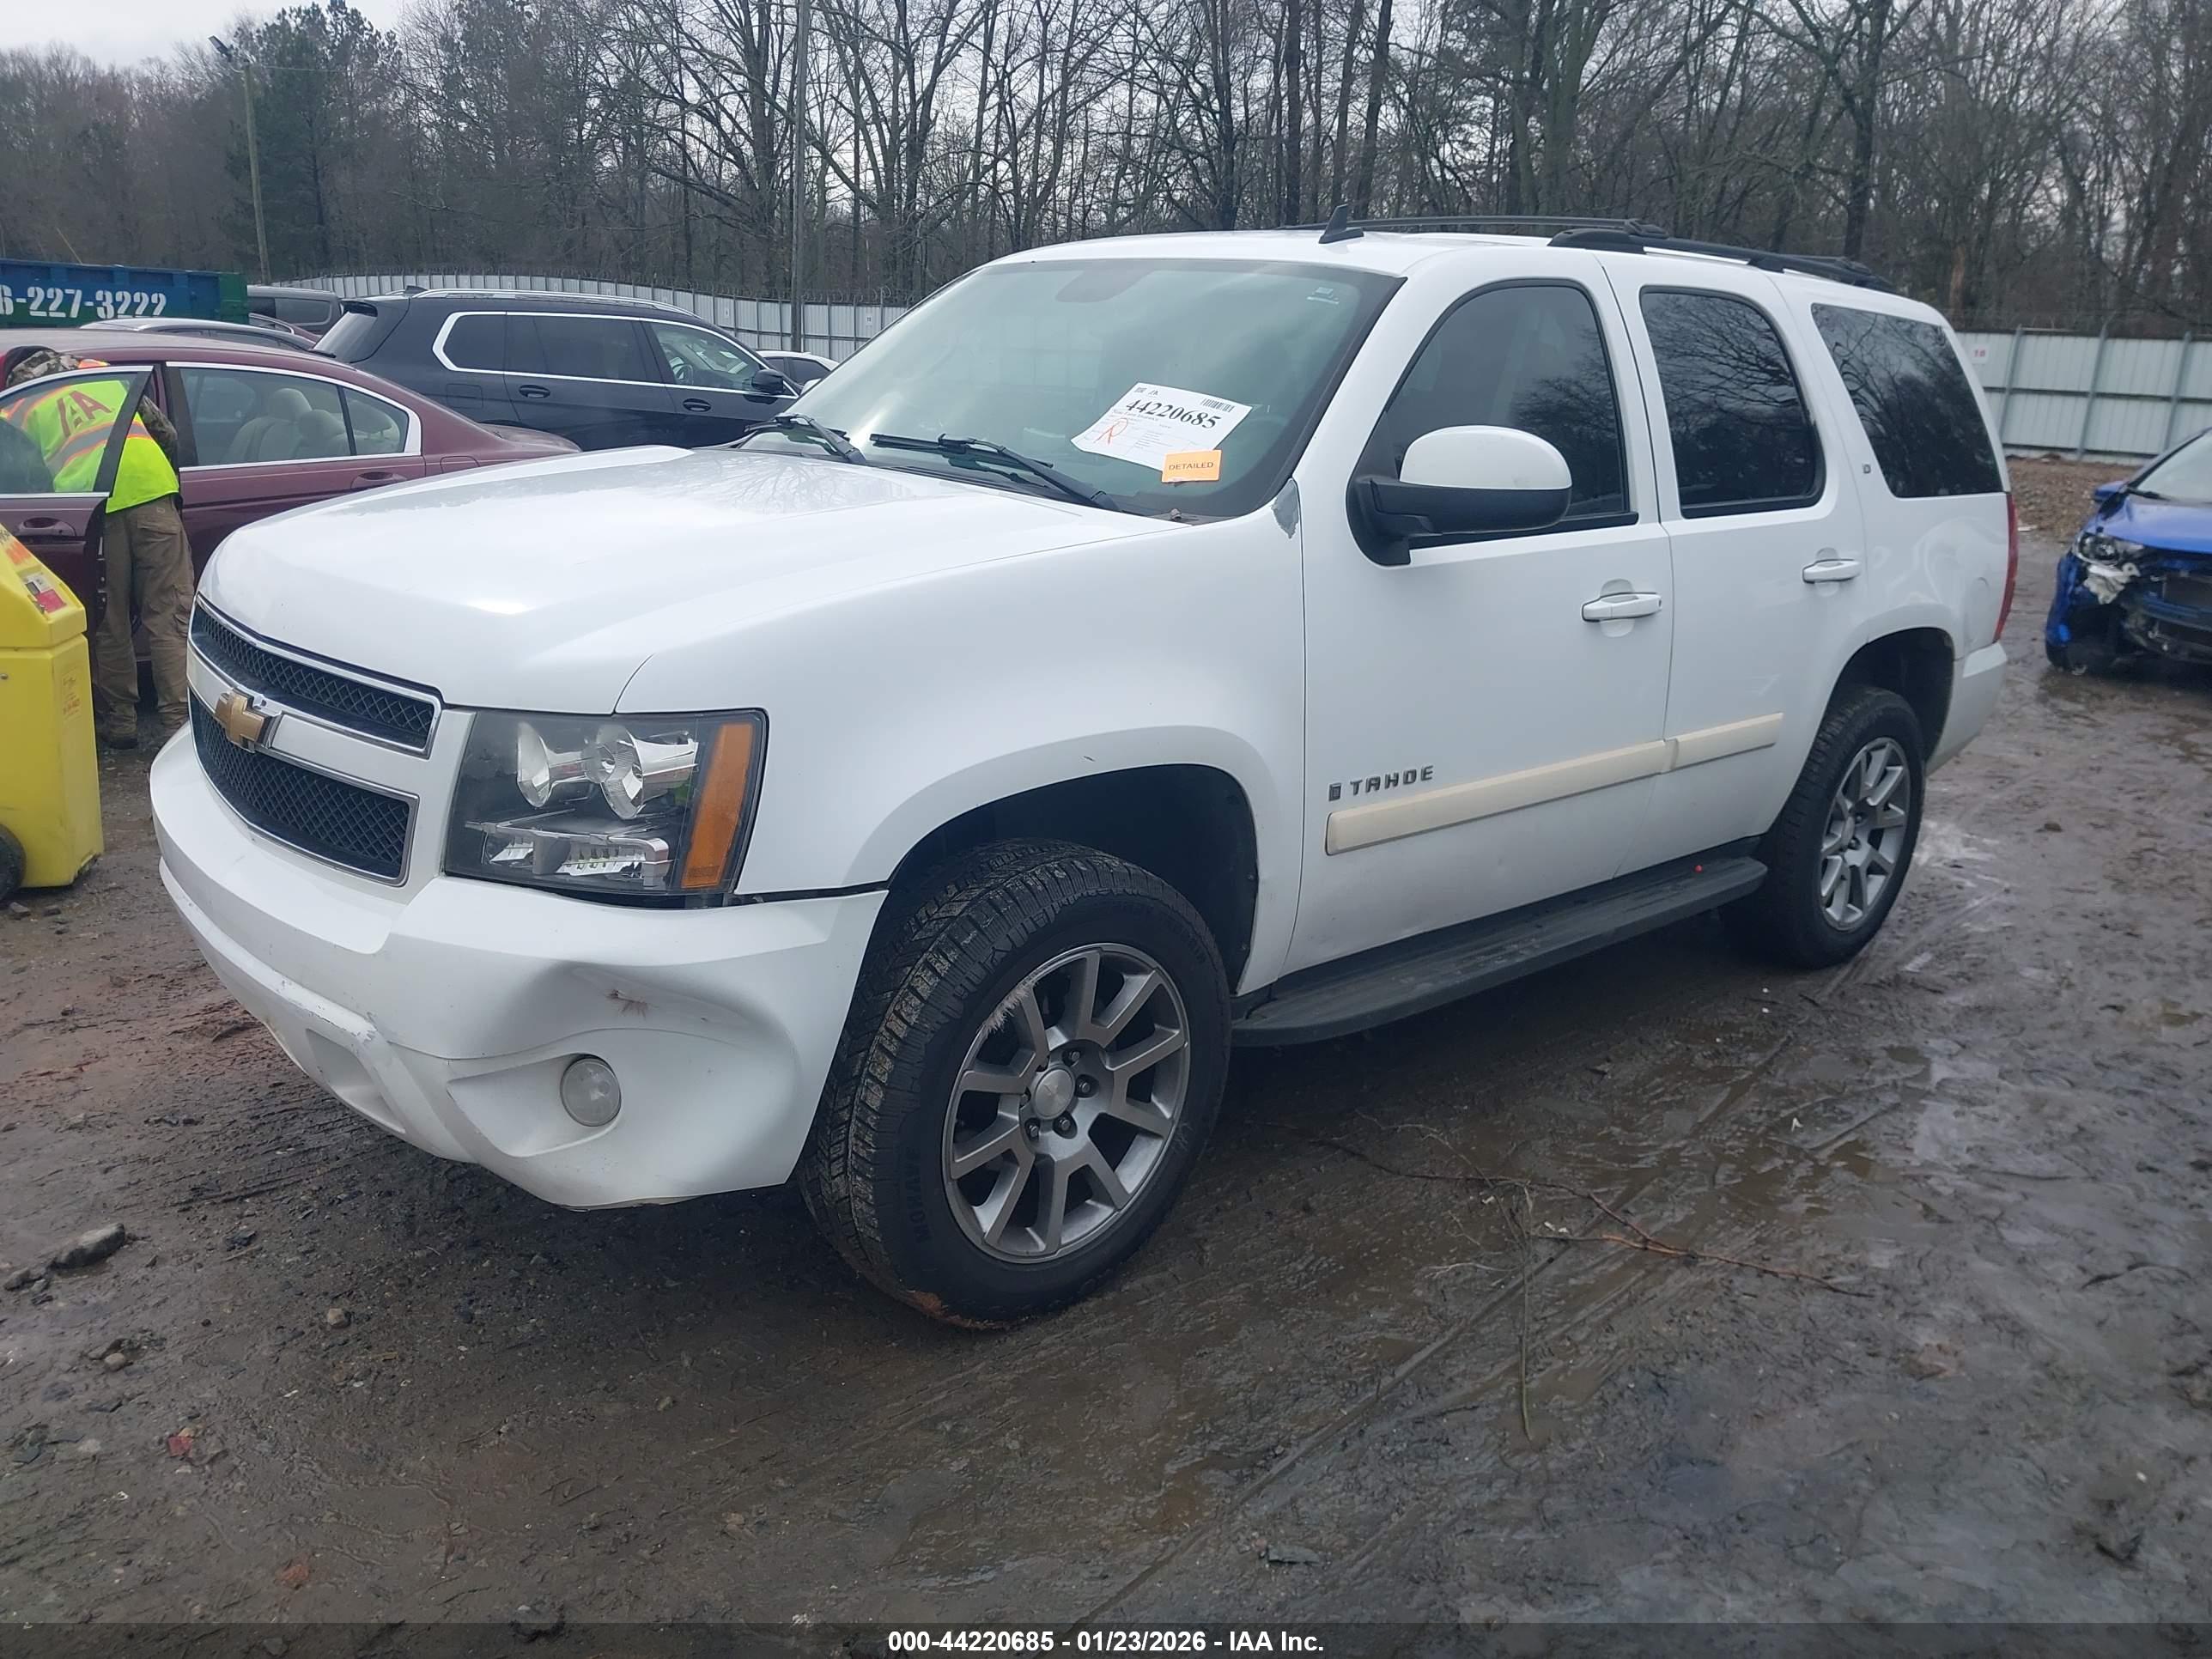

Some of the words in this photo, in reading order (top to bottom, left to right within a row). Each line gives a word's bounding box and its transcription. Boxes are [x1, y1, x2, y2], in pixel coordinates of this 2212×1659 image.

[1126, 398, 1222, 429] 44220685
[1168, 461, 1214, 471] DETAILED
[1350, 765, 1434, 796] TAHOE
